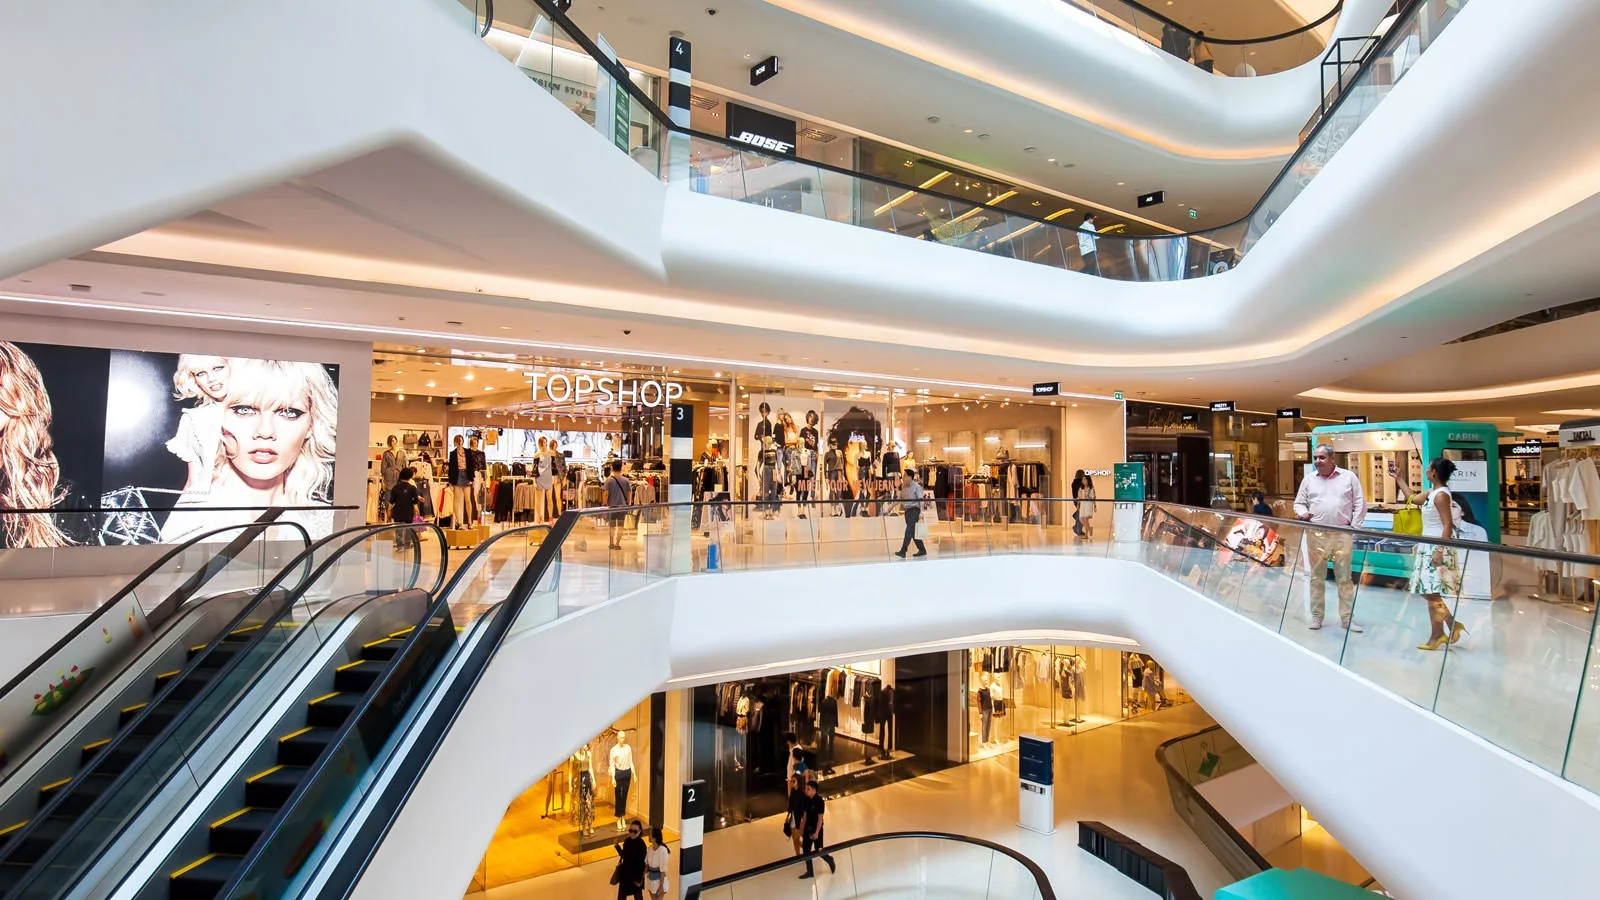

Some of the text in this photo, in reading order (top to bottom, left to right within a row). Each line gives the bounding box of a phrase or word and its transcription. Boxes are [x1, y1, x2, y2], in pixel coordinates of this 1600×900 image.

[675, 42, 683, 55] 4
[729, 131, 795, 153] BOSE
[522, 371, 683, 409] TOPSHOP
[676, 407, 684, 420] 3
[1084, 469, 1111, 477] OPSHOP
[687, 788, 696, 803] 2
